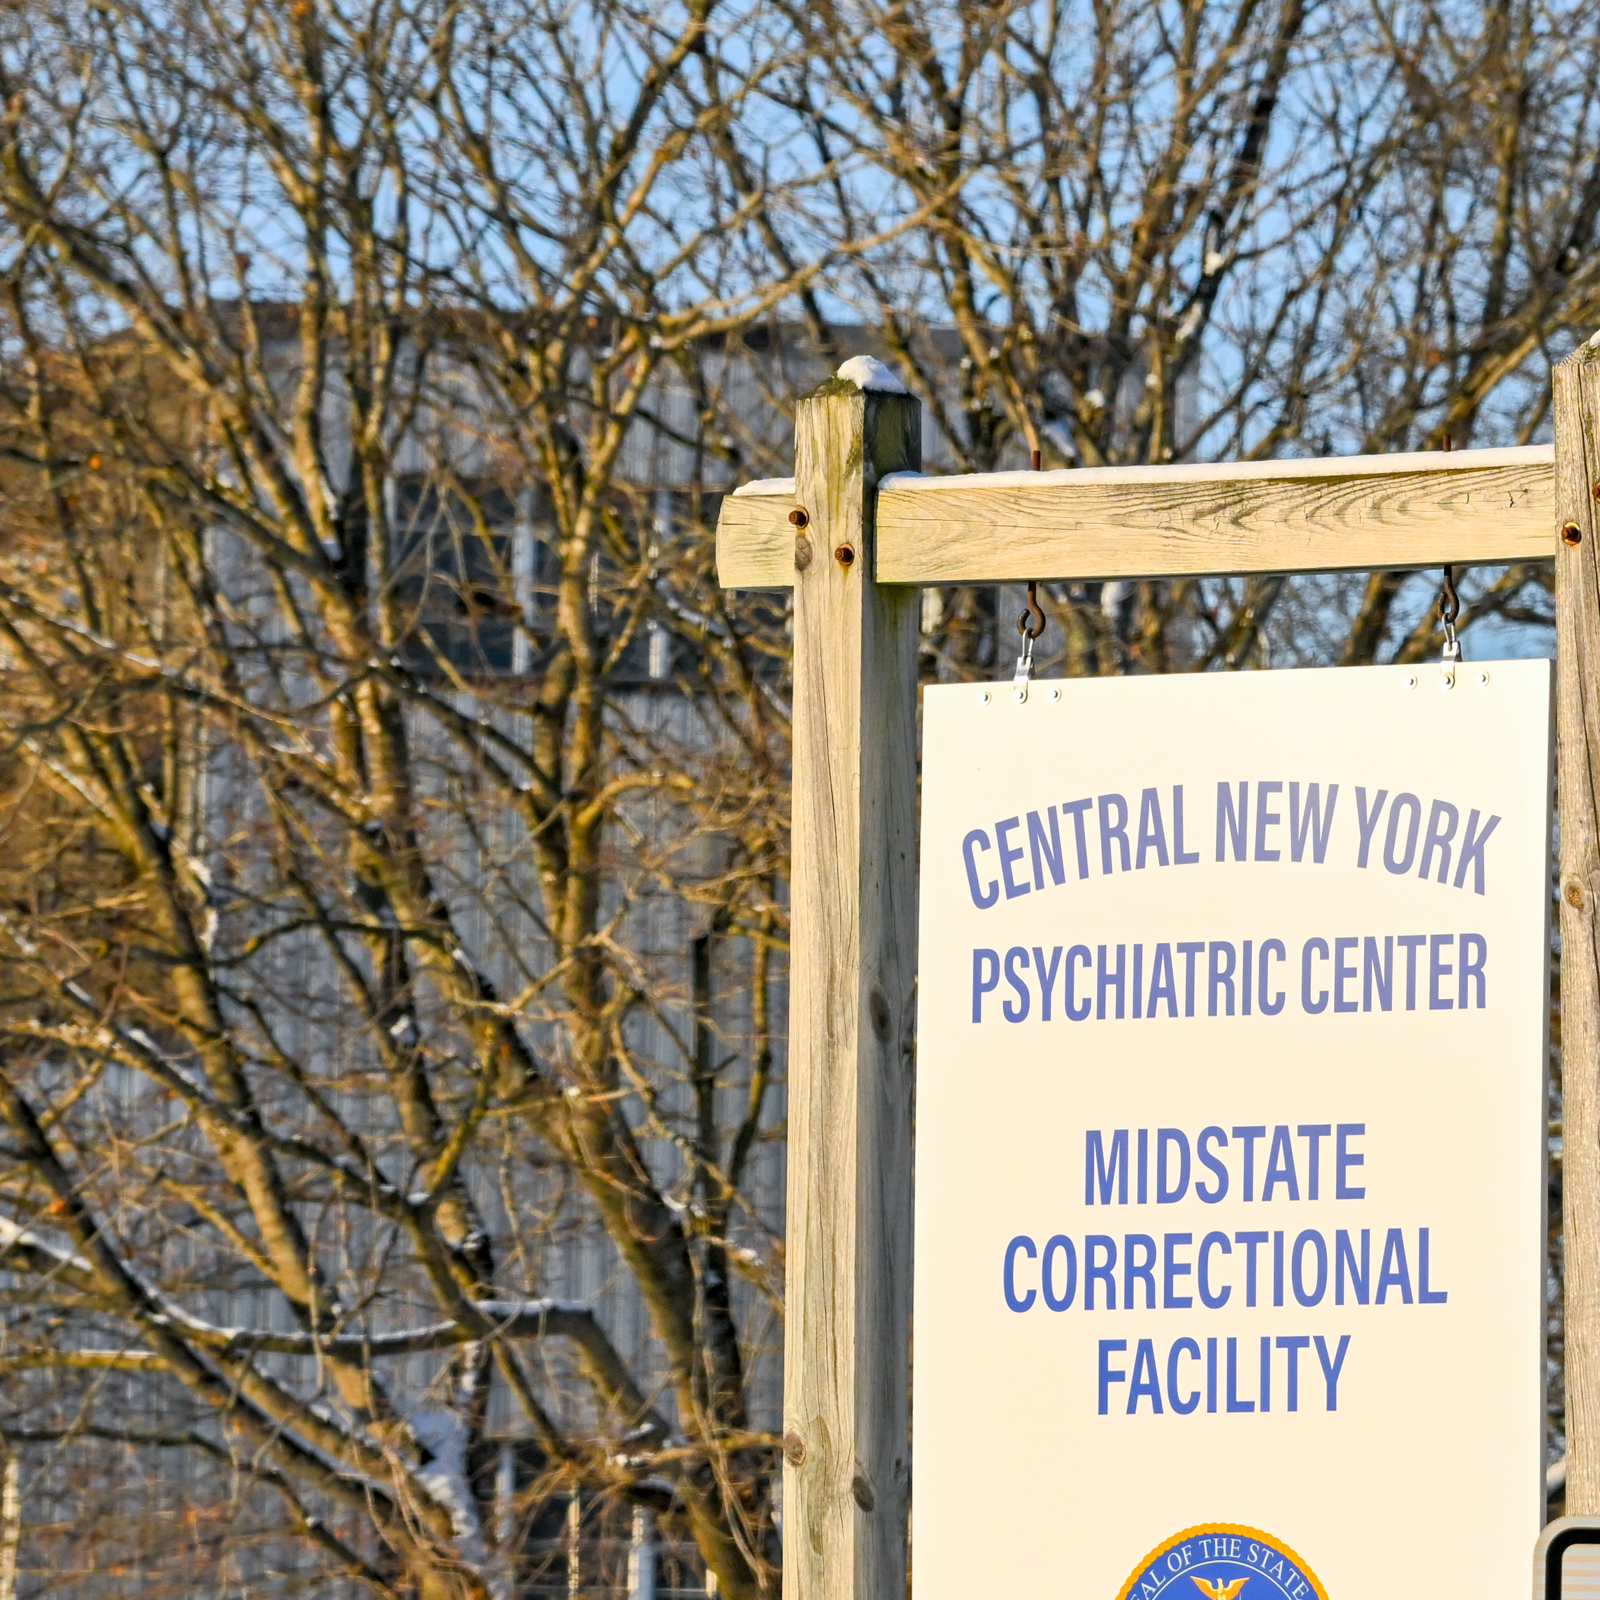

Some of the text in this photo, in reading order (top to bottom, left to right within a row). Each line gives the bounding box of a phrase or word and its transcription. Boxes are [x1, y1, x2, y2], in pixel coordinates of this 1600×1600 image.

[962, 781, 1501, 910] CENTRAL NEW YORK
[972, 933, 1487, 1024] PSYCHIATRIC CENTER
[1085, 1123, 1366, 1206] MIDSTATE
[1003, 1227, 1448, 1313] CORRECTIONAL
[1098, 1334, 1351, 1415] FACILITY
[1167, 1545, 1193, 1573] OF
[1199, 1538, 1242, 1559] THE
